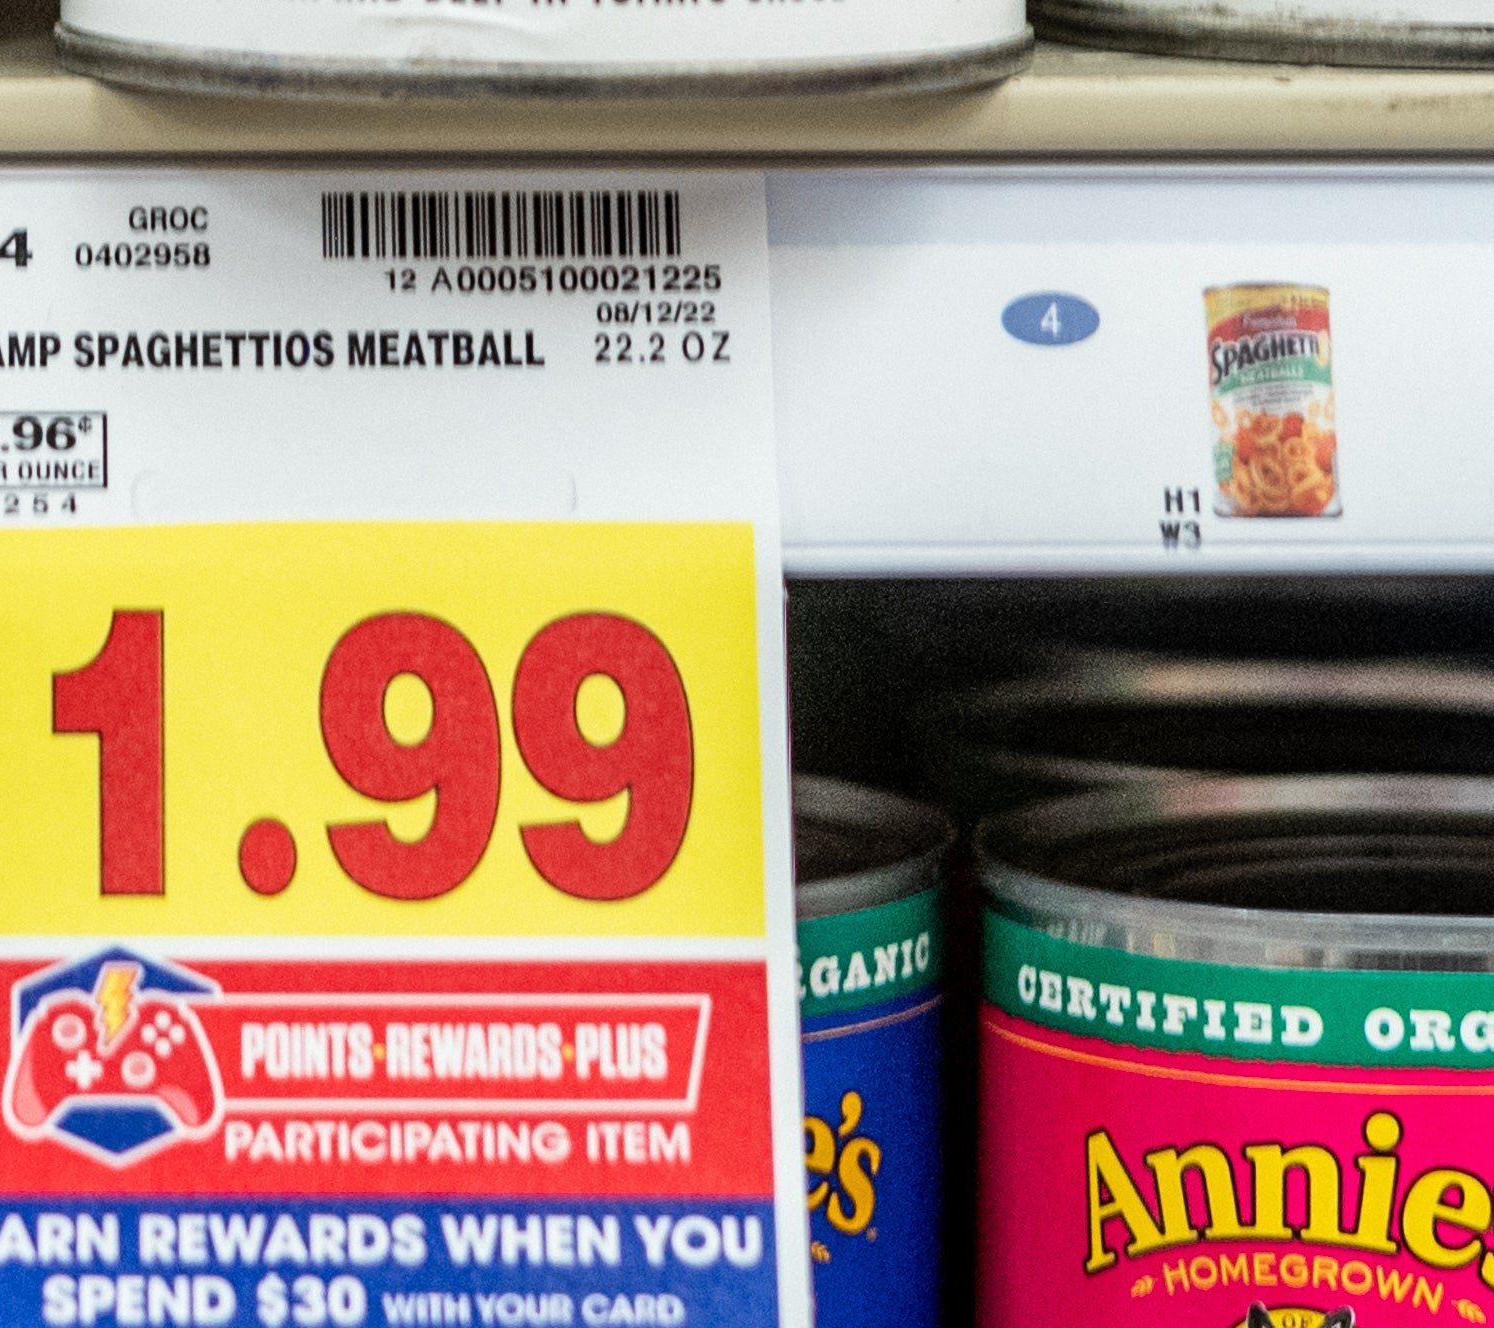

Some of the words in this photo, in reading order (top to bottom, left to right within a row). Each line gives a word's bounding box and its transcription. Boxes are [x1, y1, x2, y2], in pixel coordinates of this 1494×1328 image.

[129, 206, 208, 232] GROC
[75, 242, 211, 268] 0402958
[386, 268, 416, 291] 12
[596, 301, 715, 324] 08/12/22
[1040, 302, 1061, 337] 4
[74, 331, 334, 368] SPAGHETTIOS
[348, 331, 545, 367] MEATBALL
[595, 332, 665, 363] 22.2
[682, 331, 730, 362] OZ
[19, 461, 100, 481] OUNCE
[51, 608, 695, 904] 1.99
[1013, 960, 1324, 1052] CERTIFIED
[225, 1121, 571, 1163] PARTICIPATING
[587, 1122, 690, 1162] ITEM
[139, 1214, 426, 1266] REWARDS
[442, 1215, 615, 1266] WHEN
[635, 1215, 762, 1268] YOU
[43, 1275, 236, 1327] SPEND
[257, 1273, 366, 1328] $30
[383, 1293, 470, 1325] WITH
[476, 1293, 573, 1326] YOUR
[582, 1294, 685, 1328] CARD
[1164, 1253, 1444, 1314] HOMEGROWN
